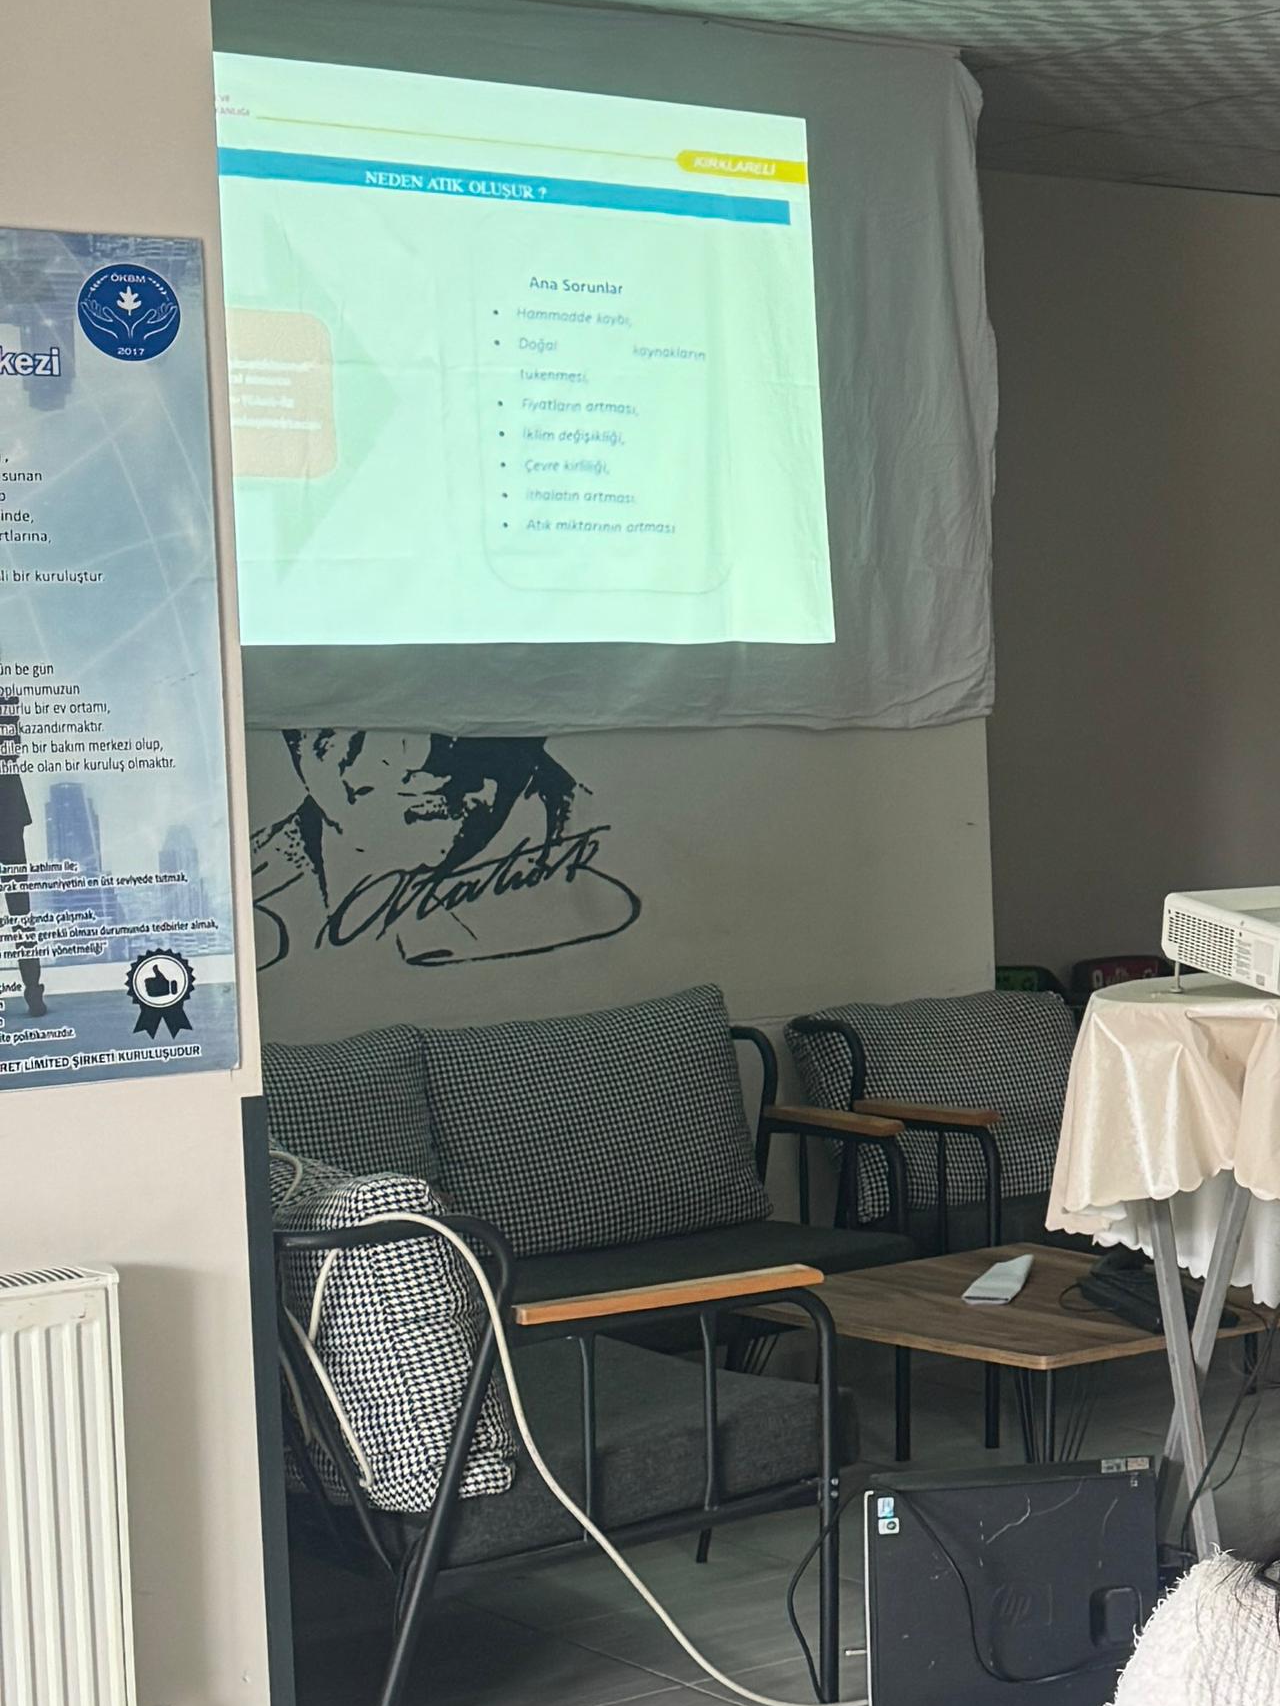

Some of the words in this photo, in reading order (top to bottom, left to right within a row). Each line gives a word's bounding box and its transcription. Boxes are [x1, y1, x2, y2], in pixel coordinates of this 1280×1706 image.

[365, 170, 423, 189] NEDEN
[427, 177, 464, 193] ATIK
[468, 181, 535, 201] OLUŞUR
[529, 276, 558, 291] Ana
[562, 279, 623, 295] Sorunlar
[517, 307, 592, 324] Hammadde
[117, 347, 145, 357] 2017
[519, 336, 558, 354] Doğal
[2, 472, 42, 482] sunan
[13, 570, 31, 582] bir
[15, 663, 30, 676] be
[34, 701, 50, 715] bir
[53, 704, 66, 714] ev
[32, 741, 47, 754] bir
[51, 740, 86, 754] bakım
[89, 739, 132, 752] merkezi
[135, 738, 164, 752] olup,
[37, 759, 62, 773] olan
[65, 759, 80, 772] bir
[84, 757, 125, 773] kuruluş
[118, 1045, 201, 1064] KURULUŞUDUR
